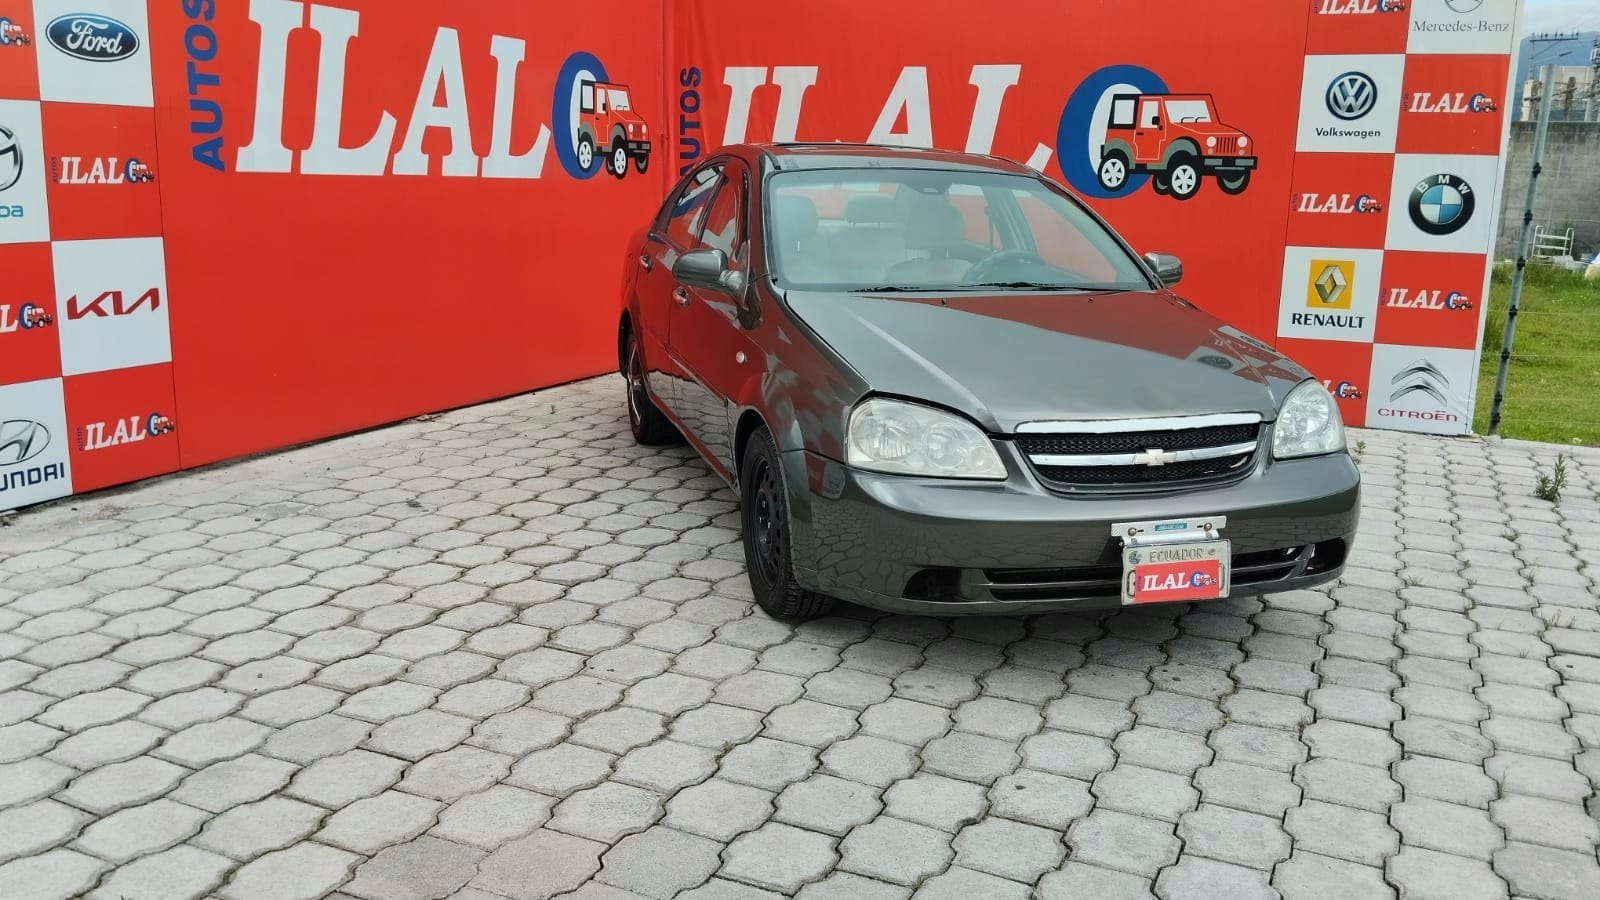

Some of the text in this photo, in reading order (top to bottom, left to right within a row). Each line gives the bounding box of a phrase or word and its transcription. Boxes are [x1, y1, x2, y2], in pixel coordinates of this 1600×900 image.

[1413, 20, 1510, 33] Mercedes-Benz
[66, 19, 122, 55] Ford
[1315, 127, 1381, 139] Volkswagen
[1416, 174, 1471, 195] BMW
[67, 288, 160, 321] KIA
[1291, 312, 1366, 329] RENAULT
[1149, 547, 1205, 563] ECUADOR
